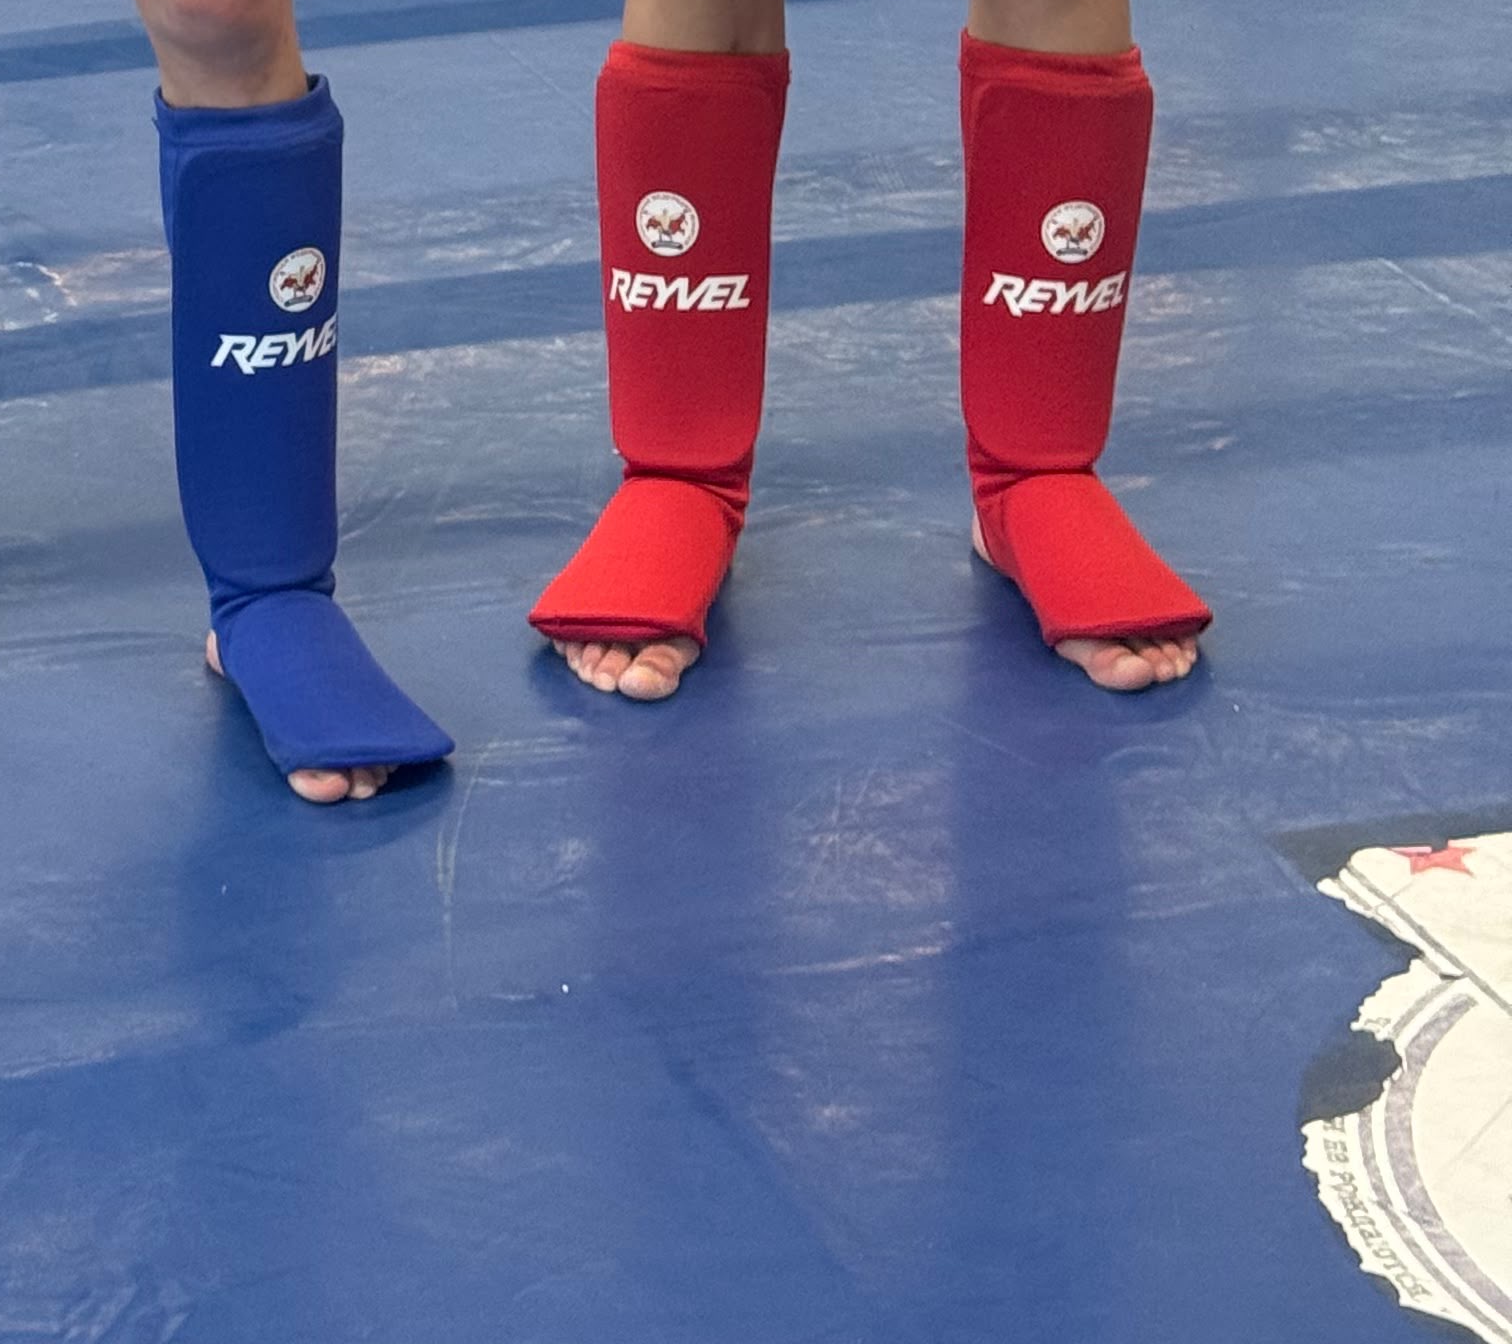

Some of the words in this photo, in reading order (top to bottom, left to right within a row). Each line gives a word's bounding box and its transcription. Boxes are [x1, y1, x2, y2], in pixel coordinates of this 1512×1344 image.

[609, 268, 751, 313] REYVEL
[982, 270, 1107, 318] REYVEL
[209, 312, 337, 375] REYVE
